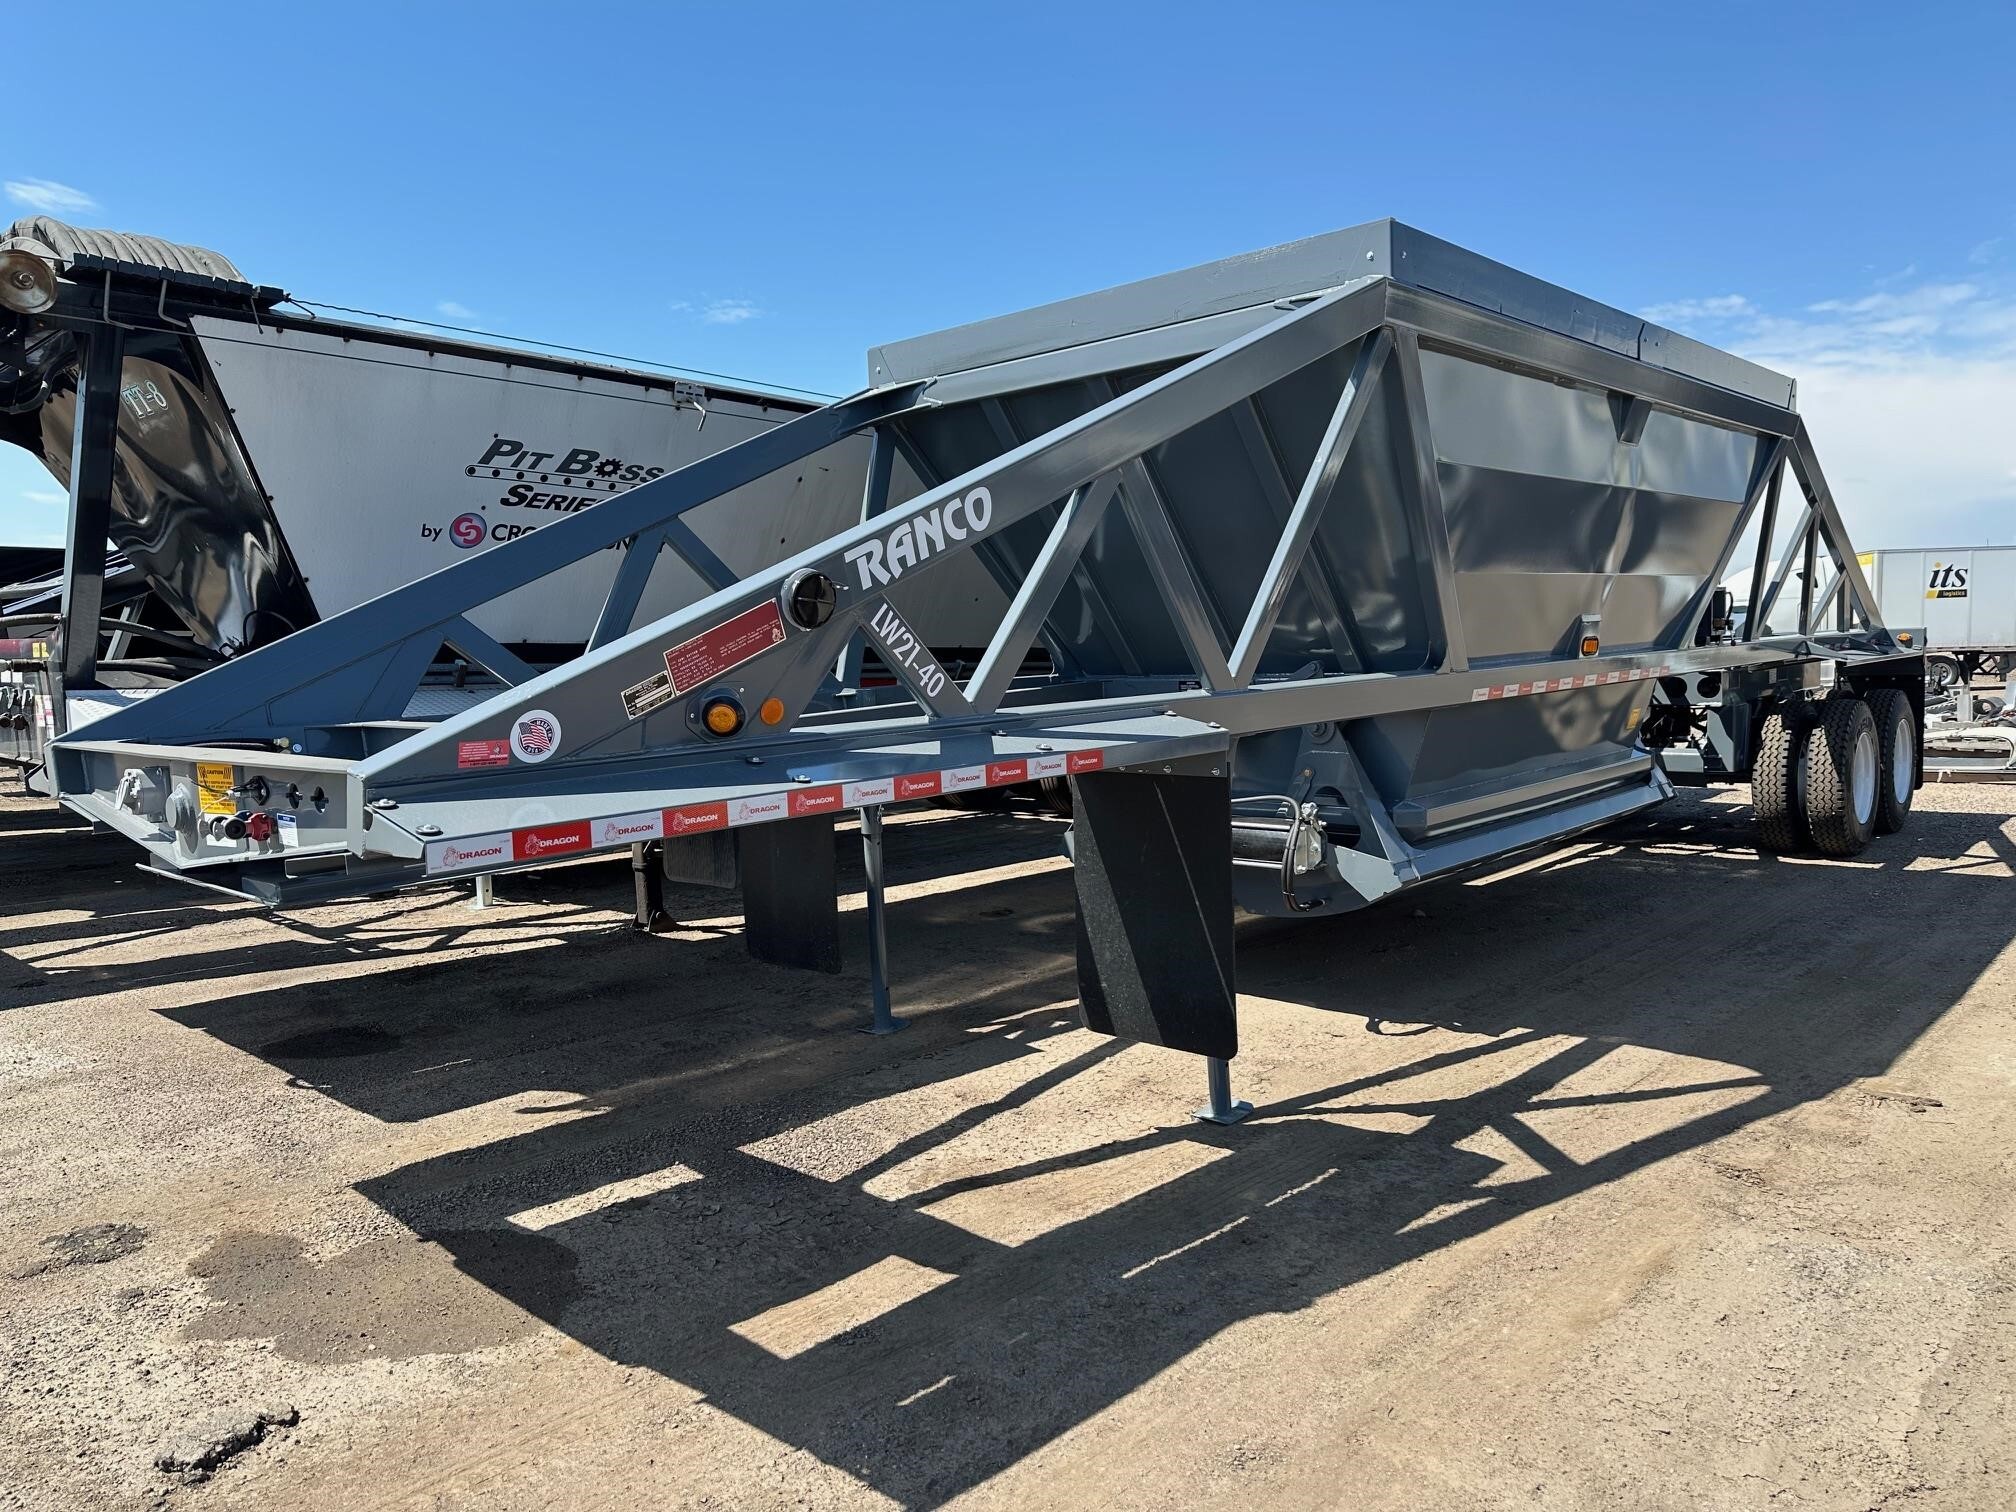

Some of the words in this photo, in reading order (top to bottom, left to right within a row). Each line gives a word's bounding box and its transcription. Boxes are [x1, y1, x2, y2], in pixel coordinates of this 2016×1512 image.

[121, 380, 168, 418] TT-8
[500, 484, 606, 513] SERIE
[421, 523, 443, 542] by
[843, 486, 993, 591] RANCO
[1929, 562, 1968, 588] its
[870, 602, 945, 698] LW21-40
[957, 774, 981, 783] DRAGON
[999, 768, 1022, 777] DRAGON
[909, 781, 935, 790] DRAGON
[861, 788, 888, 798] DRAGON
[806, 796, 835, 806] DRAGON
[750, 804, 780, 815] DRAGON
[684, 813, 719, 826] DRAGON
[617, 824, 655, 836] DRAGON
[539, 834, 579, 849] DRAGON
[458, 847, 503, 861] DRAGON
